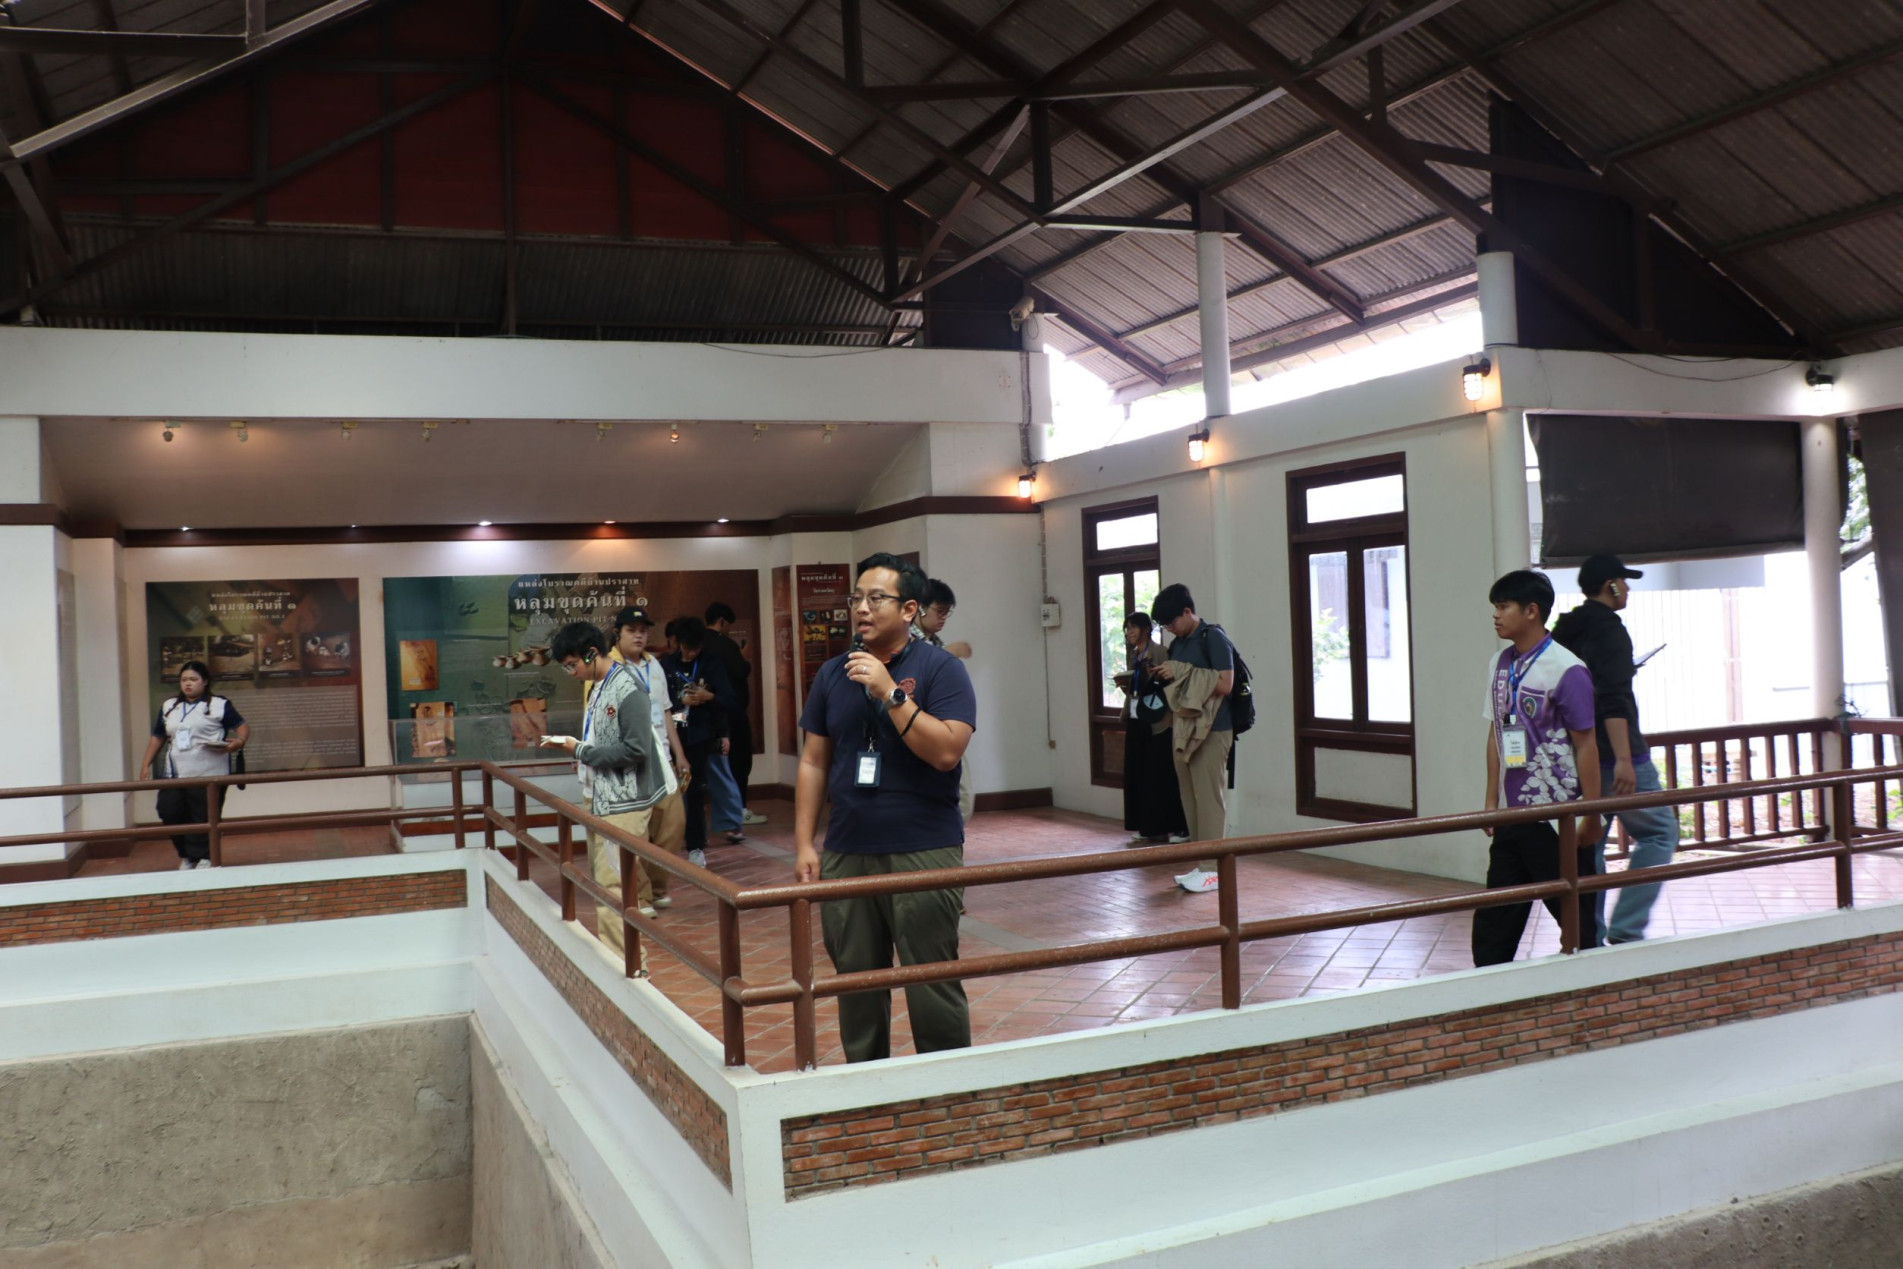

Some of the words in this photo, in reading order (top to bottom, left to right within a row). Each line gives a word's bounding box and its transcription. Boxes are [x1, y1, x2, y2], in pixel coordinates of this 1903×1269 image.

[518, 578, 640, 588] แหล่งโบราณคดีบ้านปราสาท
[514, 586, 626, 615] หลุมขุดค้นที่
